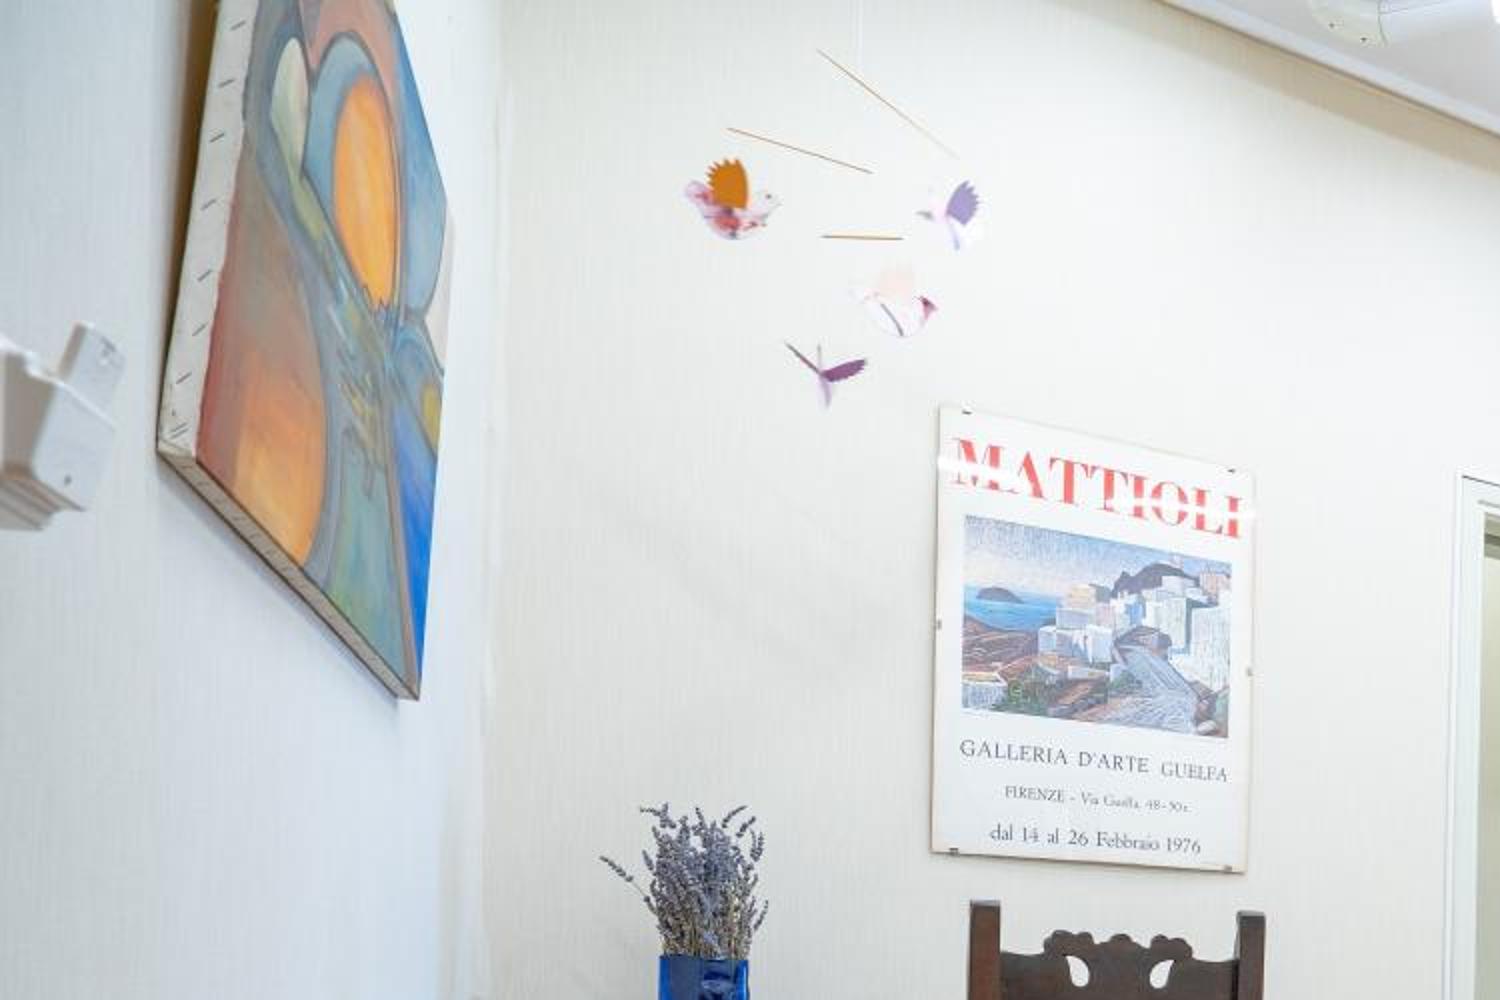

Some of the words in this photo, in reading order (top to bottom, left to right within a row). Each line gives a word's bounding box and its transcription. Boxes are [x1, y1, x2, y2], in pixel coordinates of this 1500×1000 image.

[951, 437, 1244, 538] MATTIOLI
[960, 739, 1068, 765] GALLERIA
[1078, 751, 1149, 774] D'ARTE
[1161, 762, 1228, 782] GUELFA
[1005, 785, 1065, 804] FIRENZE
[1081, 792, 1100, 806] Via
[990, 823, 1013, 841] dal
[1022, 827, 1040, 843] 14
[1047, 828, 1059, 844] al
[1067, 829, 1088, 846] 26
[1096, 831, 1160, 850] Febbraio
[1167, 835, 1200, 854] 1976
